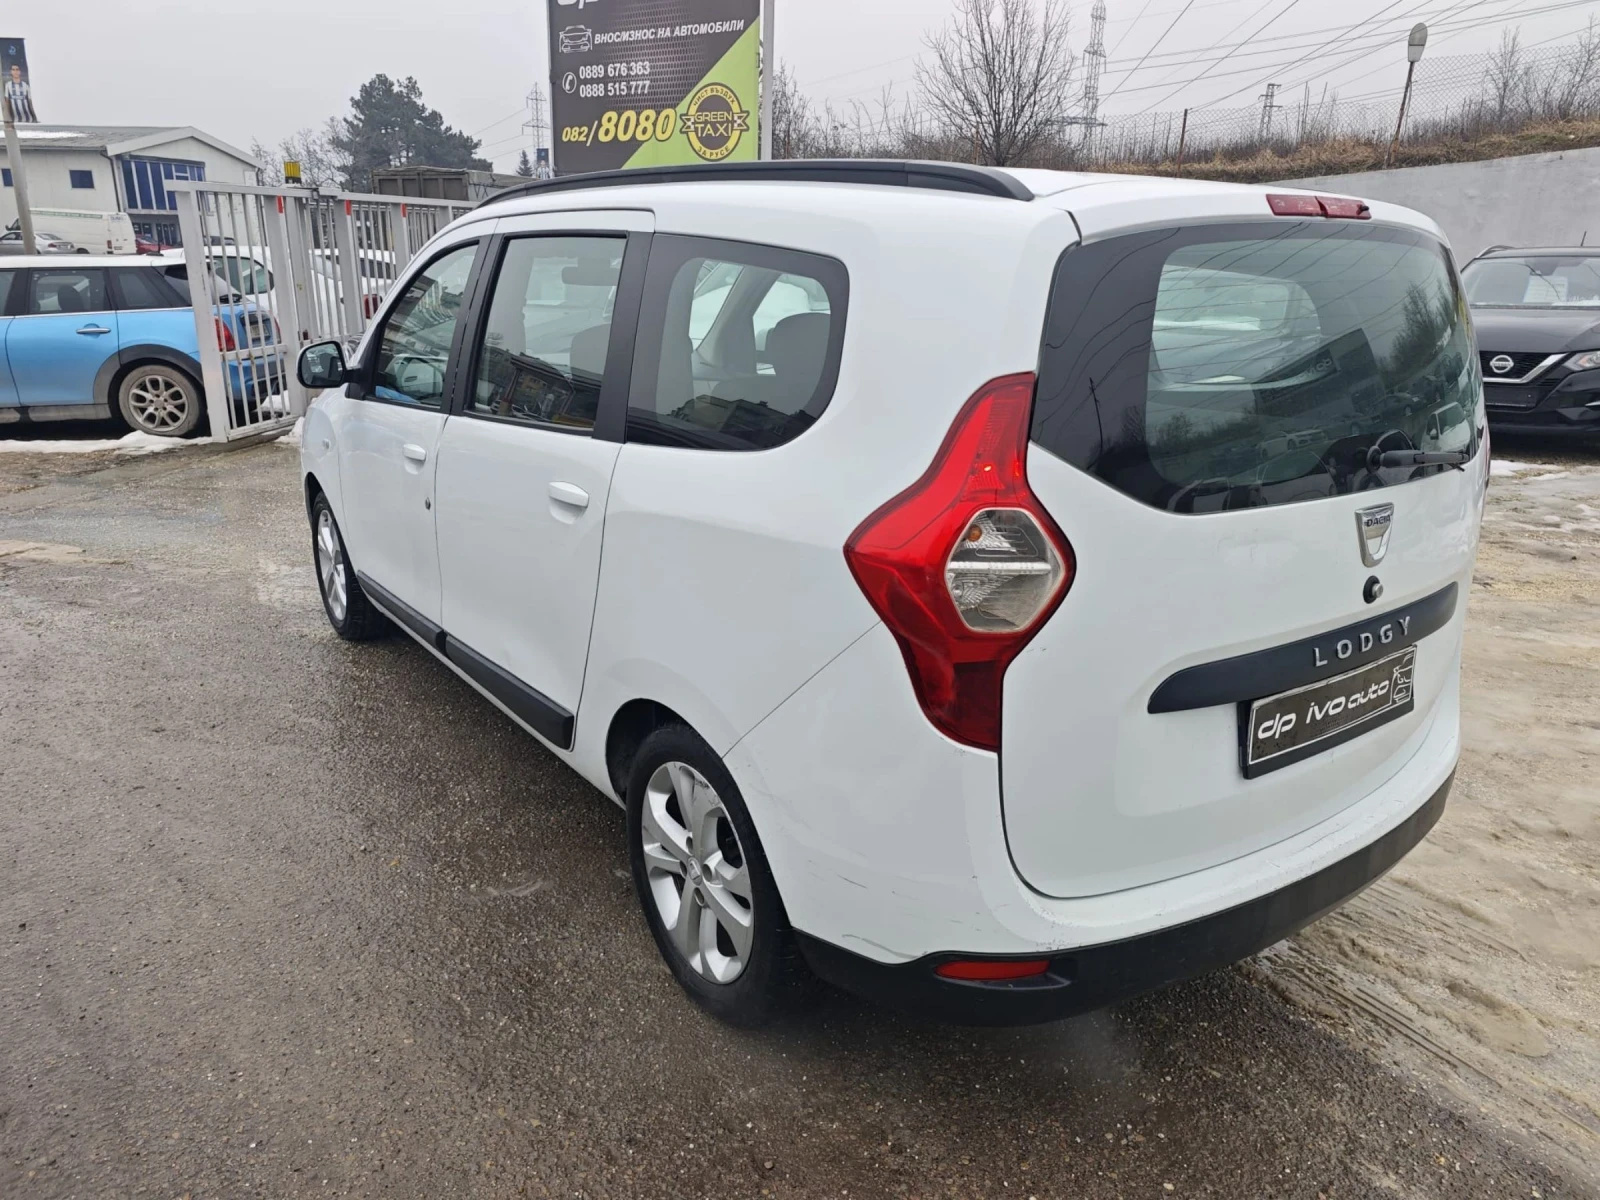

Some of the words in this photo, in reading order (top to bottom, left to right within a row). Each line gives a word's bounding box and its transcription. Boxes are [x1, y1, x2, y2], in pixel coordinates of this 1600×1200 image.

[594, 28, 655, 44] ВНОС/ИЗНОС
[657, 26, 671, 38] НА
[673, 19, 745, 37] АВТОМОБИЛИ
[579, 65, 604, 79] 0889
[607, 63, 627, 77] 676
[629, 61, 650, 75] 363
[579, 83, 604, 98] 0888
[607, 82, 627, 96] 515
[629, 80, 650, 94] 777
[693, 89, 708, 106] ЧИСТ
[710, 87, 735, 105] ВЪЗДУХ
[694, 111, 733, 122] GREEN
[694, 123, 732, 137] TAXI
[697, 145, 707, 157] ЗА
[709, 146, 730, 158] РУСЕ
[1366, 514, 1391, 527] DACIA
[1313, 616, 1411, 667] LODGY
[1305, 695, 1346, 724] ivo
[1347, 680, 1389, 709] auto
